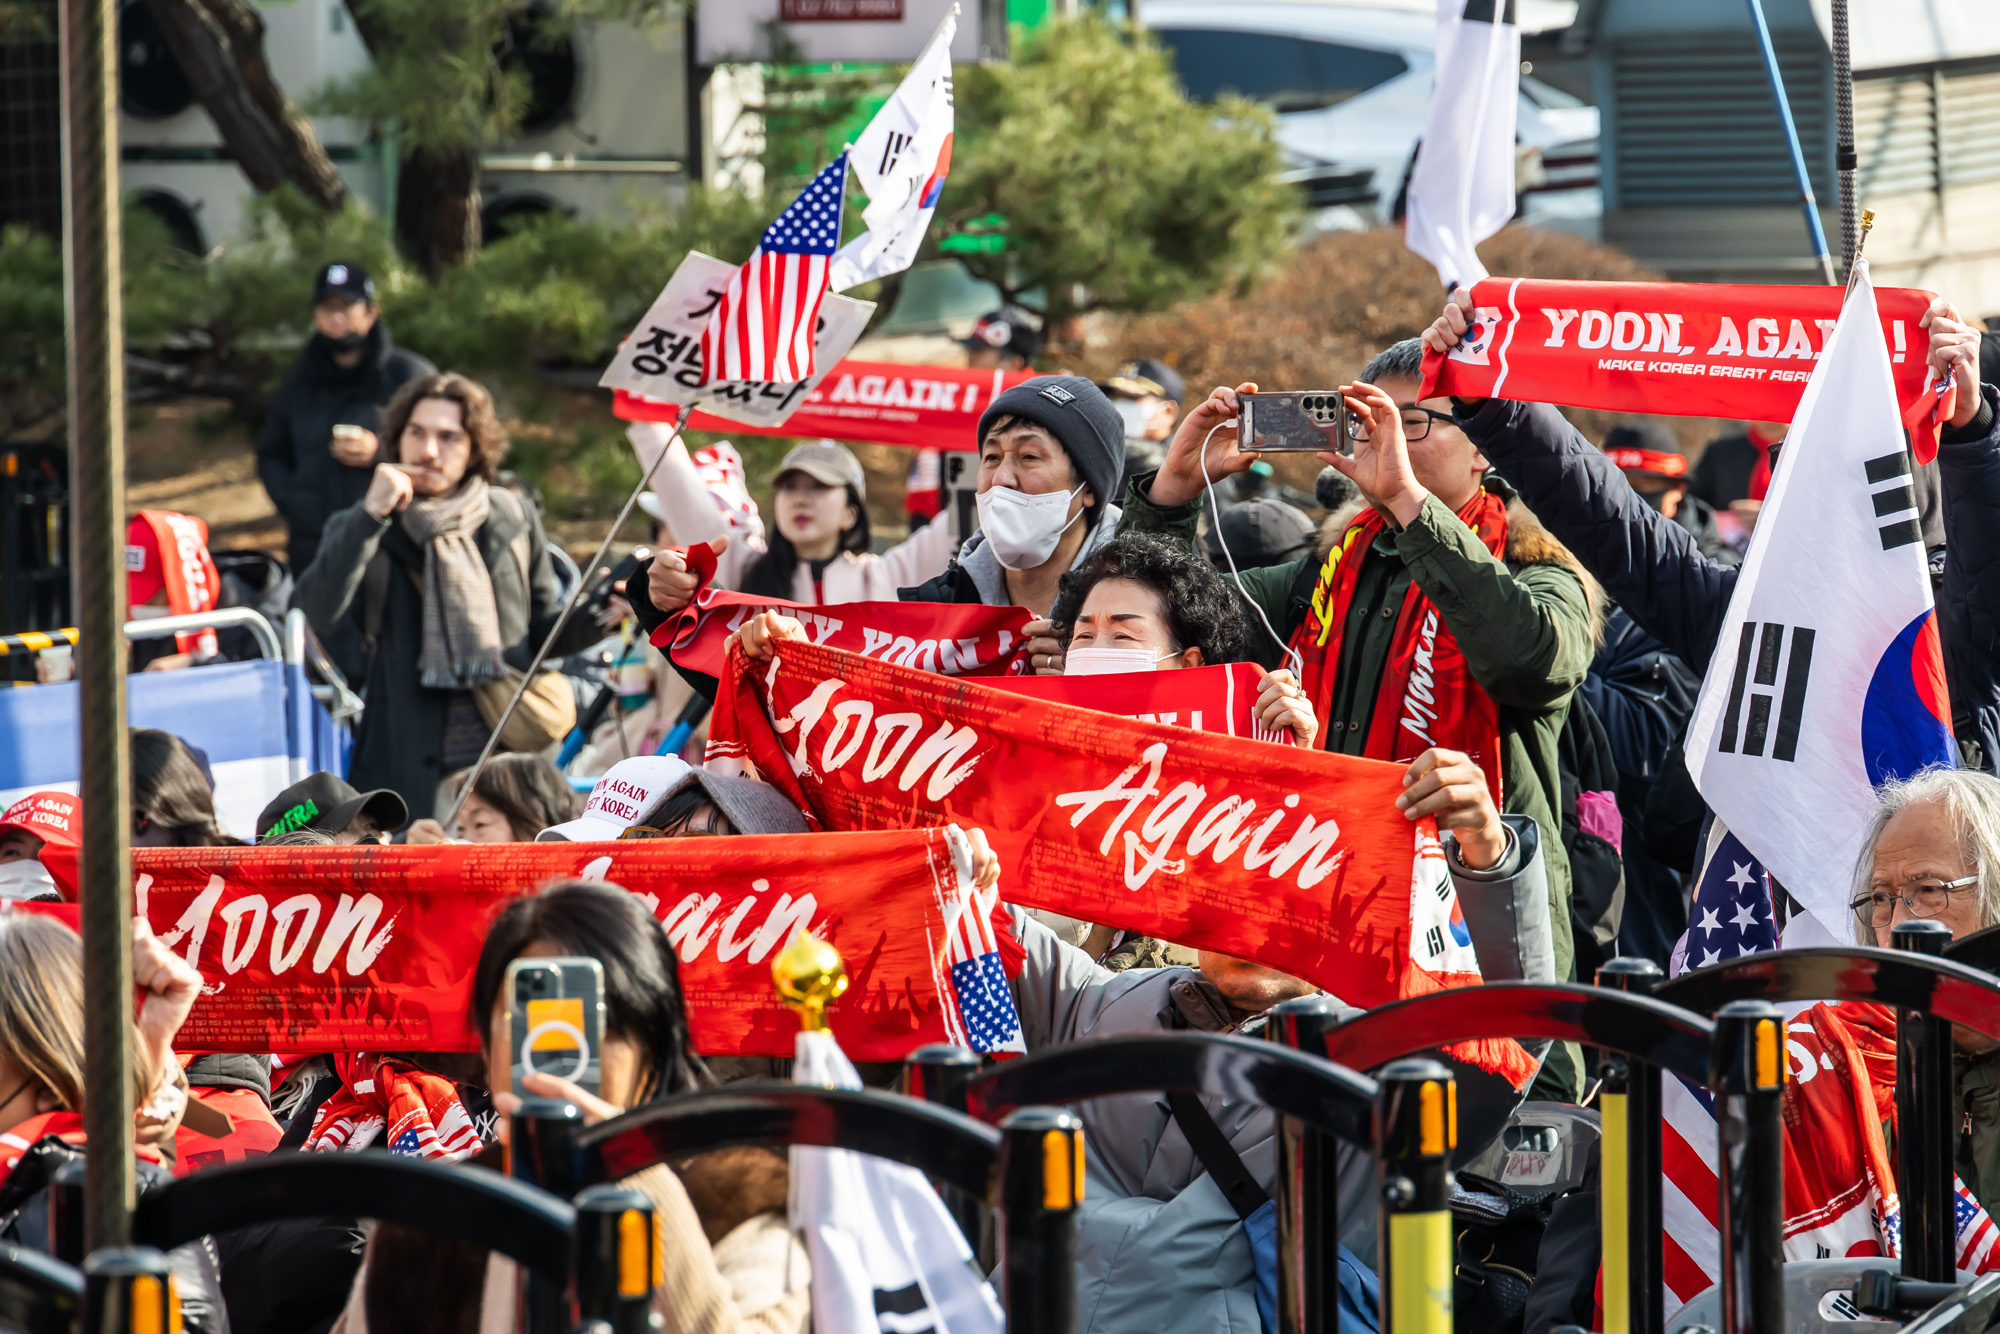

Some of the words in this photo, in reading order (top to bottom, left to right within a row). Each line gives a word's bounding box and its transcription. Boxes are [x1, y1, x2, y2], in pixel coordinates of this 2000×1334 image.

[1540, 308, 1695, 358] YOON,
[1706, 316, 1836, 361] AGAI
[1598, 359, 1645, 372] MAKE
[1648, 361, 1705, 375] KOREA
[1709, 365, 1767, 380] GREAT
[1769, 370, 1812, 382] AGAI
[829, 373, 960, 411] AGAIN
[765, 655, 995, 802] Yoon
[609, 778, 649, 803] AGAIN
[31, 810, 69, 832] KOREA
[36, 798, 74, 816] AGAIN
[600, 797, 640, 821] KOREA
[1055, 742, 1348, 892] Again
[134, 872, 405, 997] Yoon
